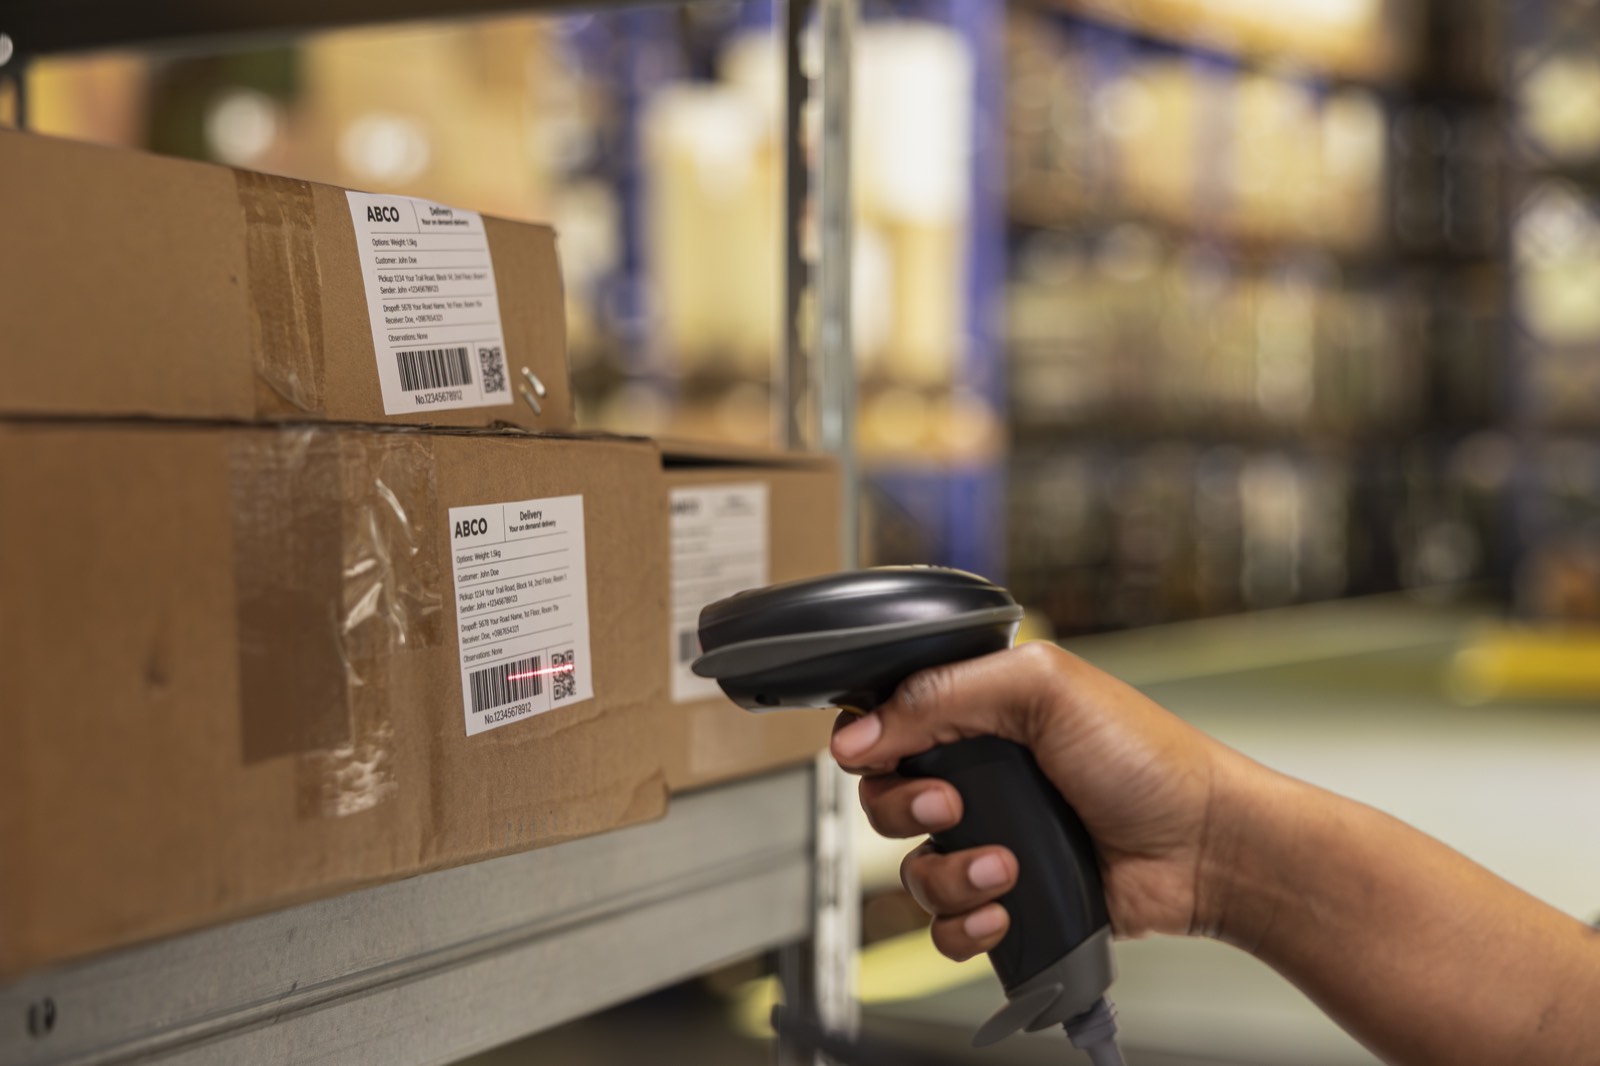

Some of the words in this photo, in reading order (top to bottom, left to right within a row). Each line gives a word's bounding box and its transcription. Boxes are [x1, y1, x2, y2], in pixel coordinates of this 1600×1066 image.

[367, 206, 400, 222] ABCO
[429, 206, 453, 219] Delivery
[372, 238, 390, 247] Options:
[406, 238, 418, 248] 1.5kg
[376, 256, 397, 264] Customer:
[398, 256, 408, 264] John
[408, 256, 417, 264] Doe
[378, 274, 394, 283] Pickup:
[394, 274, 405, 282] 1234
[380, 286, 396, 294] Sender:
[415, 390, 463, 405] No.12345678912
[520, 510, 542, 521] Delivery
[455, 518, 488, 539] ABCO
[525, 522, 540, 530] demand
[542, 520, 556, 528] delivery
[456, 554, 474, 564] Options:
[474, 552, 490, 562] Weight:
[490, 550, 502, 558] 1.5kg
[458, 574, 478, 583] Customer:
[480, 570, 490, 579] John
[490, 569, 499, 577] Doe
[459, 592, 474, 602] Pickup:
[474, 590, 485, 598] 1234
[485, 588, 495, 596] Your
[495, 586, 504, 594] Trail
[504, 584, 516, 592] Road,
[516, 582, 527, 590] Block
[460, 604, 475, 614] Sender:
[476, 601, 486, 610] John
[478, 618, 489, 628] 5678
[510, 613, 524, 621] Name,
[462, 634, 480, 644] Receiver:
[481, 632, 491, 640] Doe,
[464, 650, 491, 663] Observations:
[492, 648, 503, 656] None
[484, 702, 531, 725] No.12345678912
